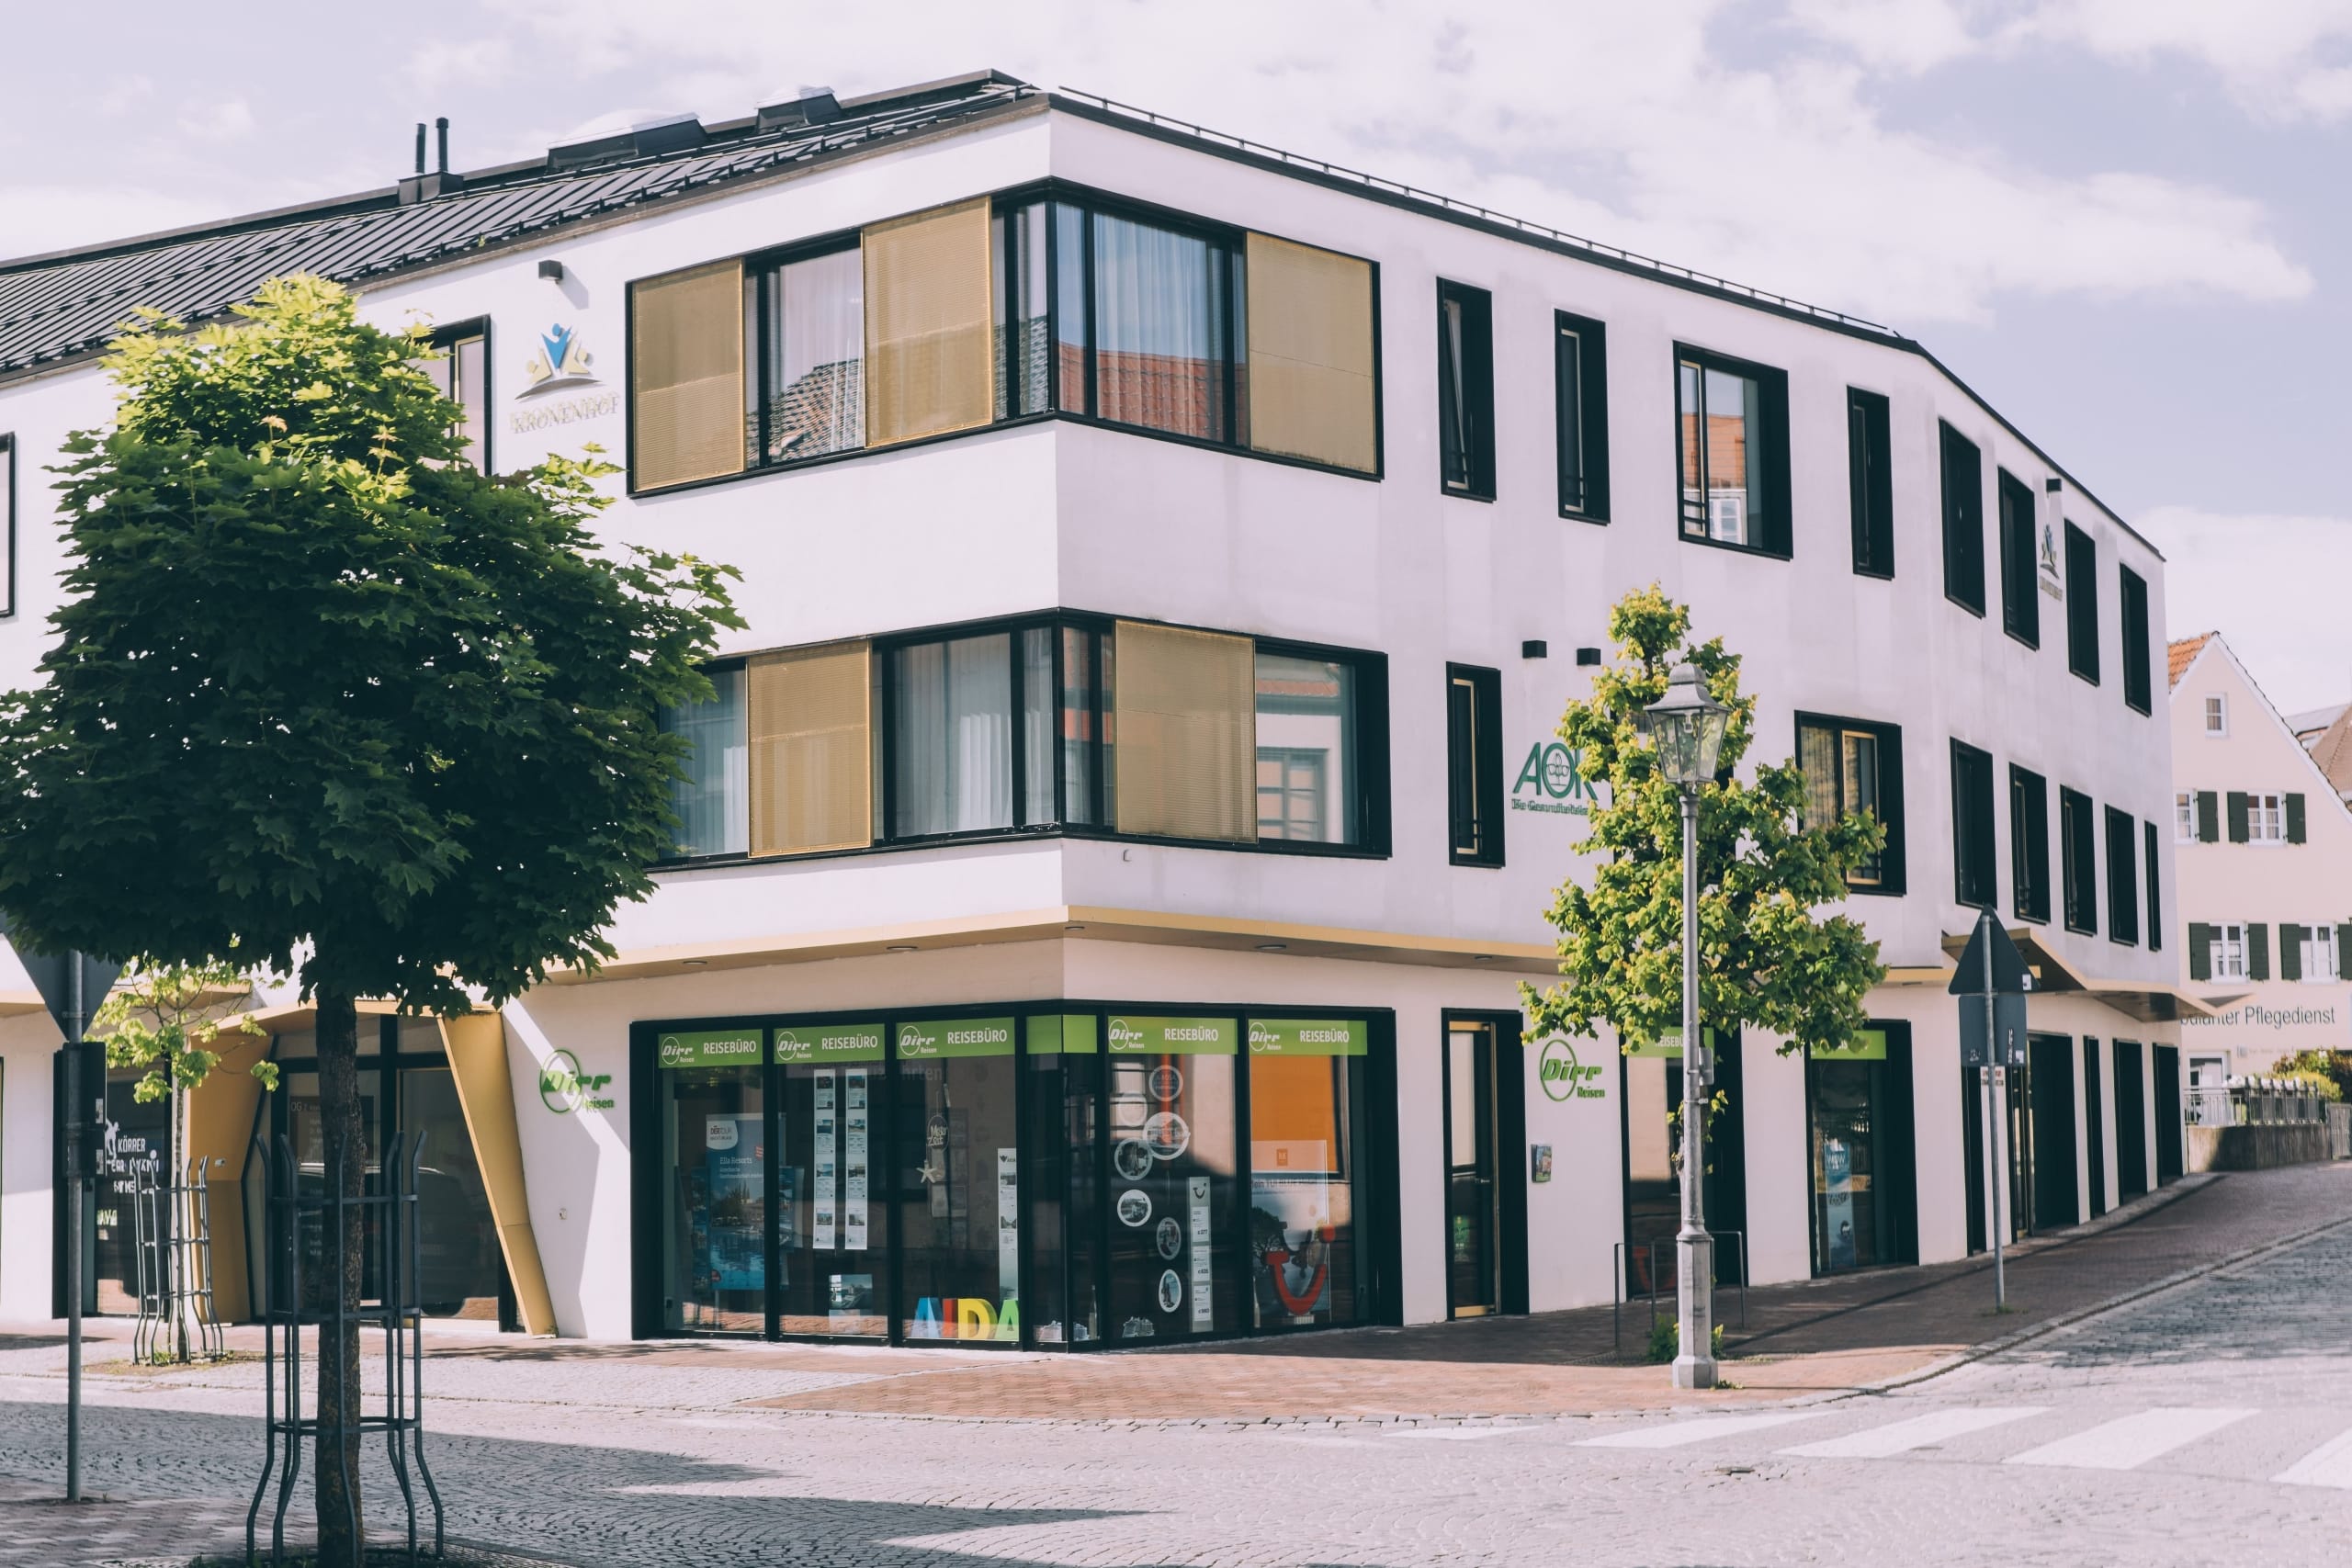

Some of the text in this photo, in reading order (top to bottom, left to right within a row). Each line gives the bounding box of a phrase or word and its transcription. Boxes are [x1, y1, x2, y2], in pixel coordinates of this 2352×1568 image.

[511, 392, 619, 434] KRONENHOF
[1512, 741, 1598, 799] AOK
[2245, 1006, 2336, 1029] Pflegedienst
[777, 1033, 878, 1052] Dirr REISEBÜRO
[900, 1027, 1008, 1046] Dirr REISEBÜRO
[1109, 1026, 1219, 1042] Dirr REISEBÜRO
[1250, 1028, 1350, 1043] Dirr REISEBÜRO
[662, 1038, 757, 1056] Dirr REISEBÜRO
[1543, 1058, 1603, 1081] Dirr
[541, 1070, 612, 1092] Dirr
[1577, 1086, 1605, 1098] Reisen
[910, 1297, 1020, 1341] AIDA
